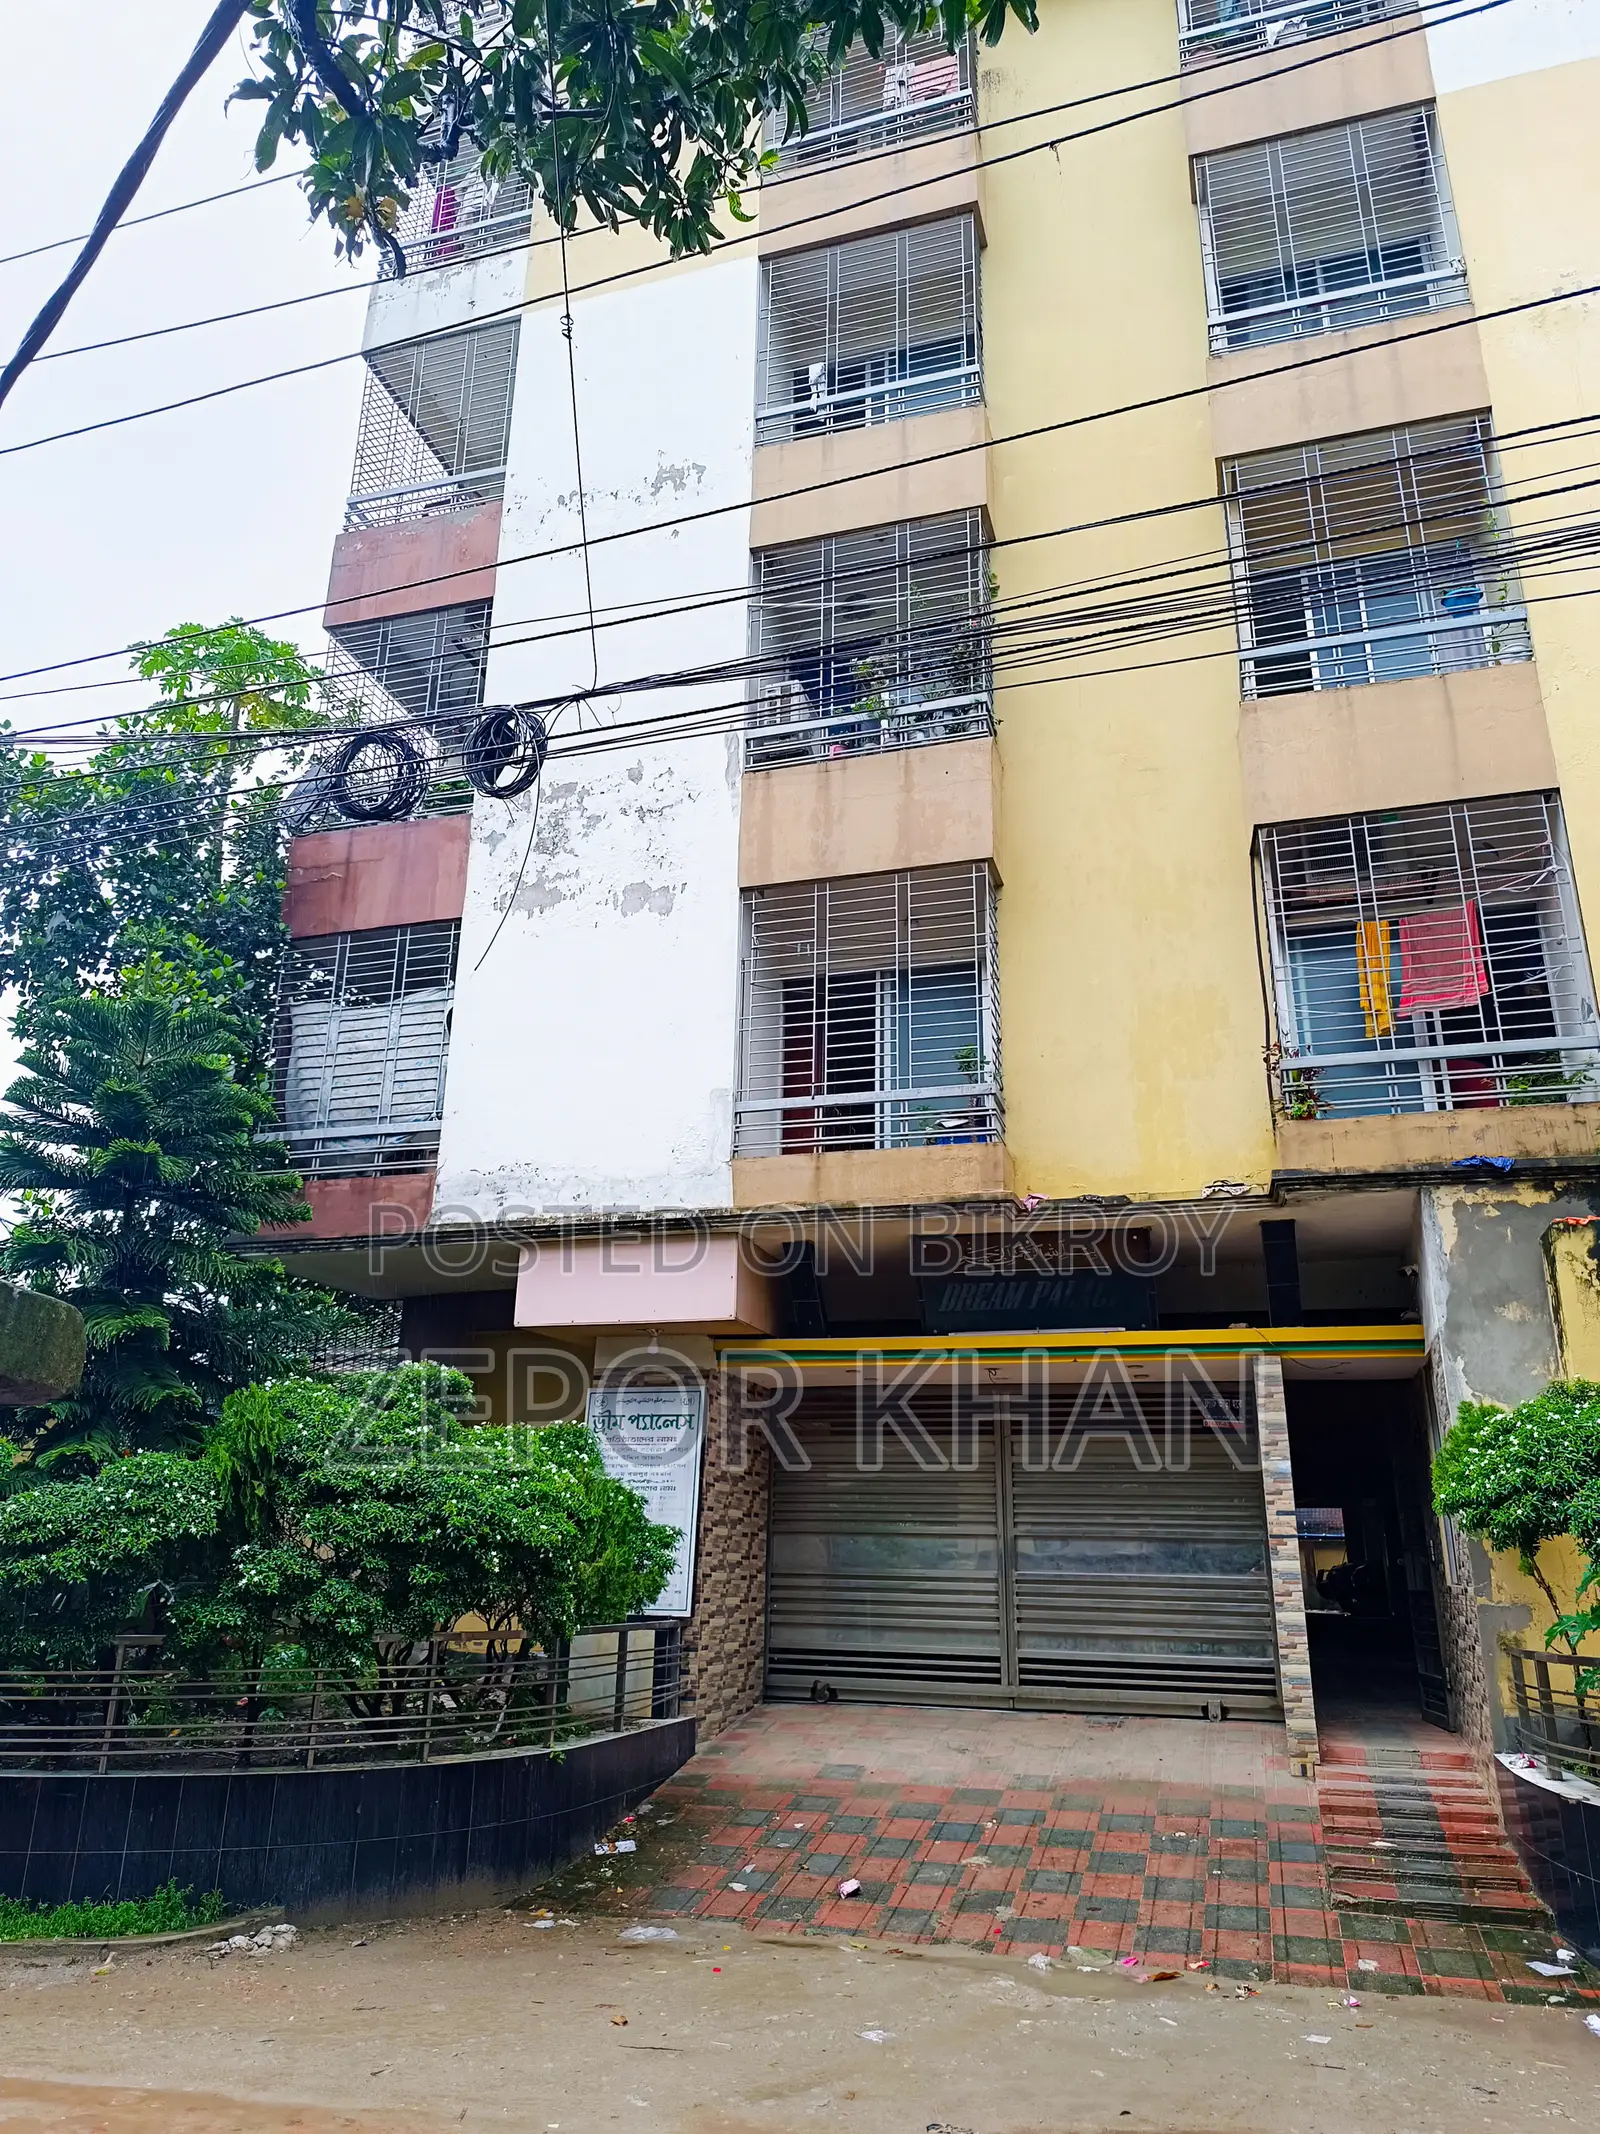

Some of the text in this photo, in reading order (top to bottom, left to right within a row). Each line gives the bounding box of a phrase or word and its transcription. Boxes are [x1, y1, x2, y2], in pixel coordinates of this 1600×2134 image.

[938, 1280, 1116, 1312] DREAM PALC
[627, 1412, 696, 1431] প্যালেস
